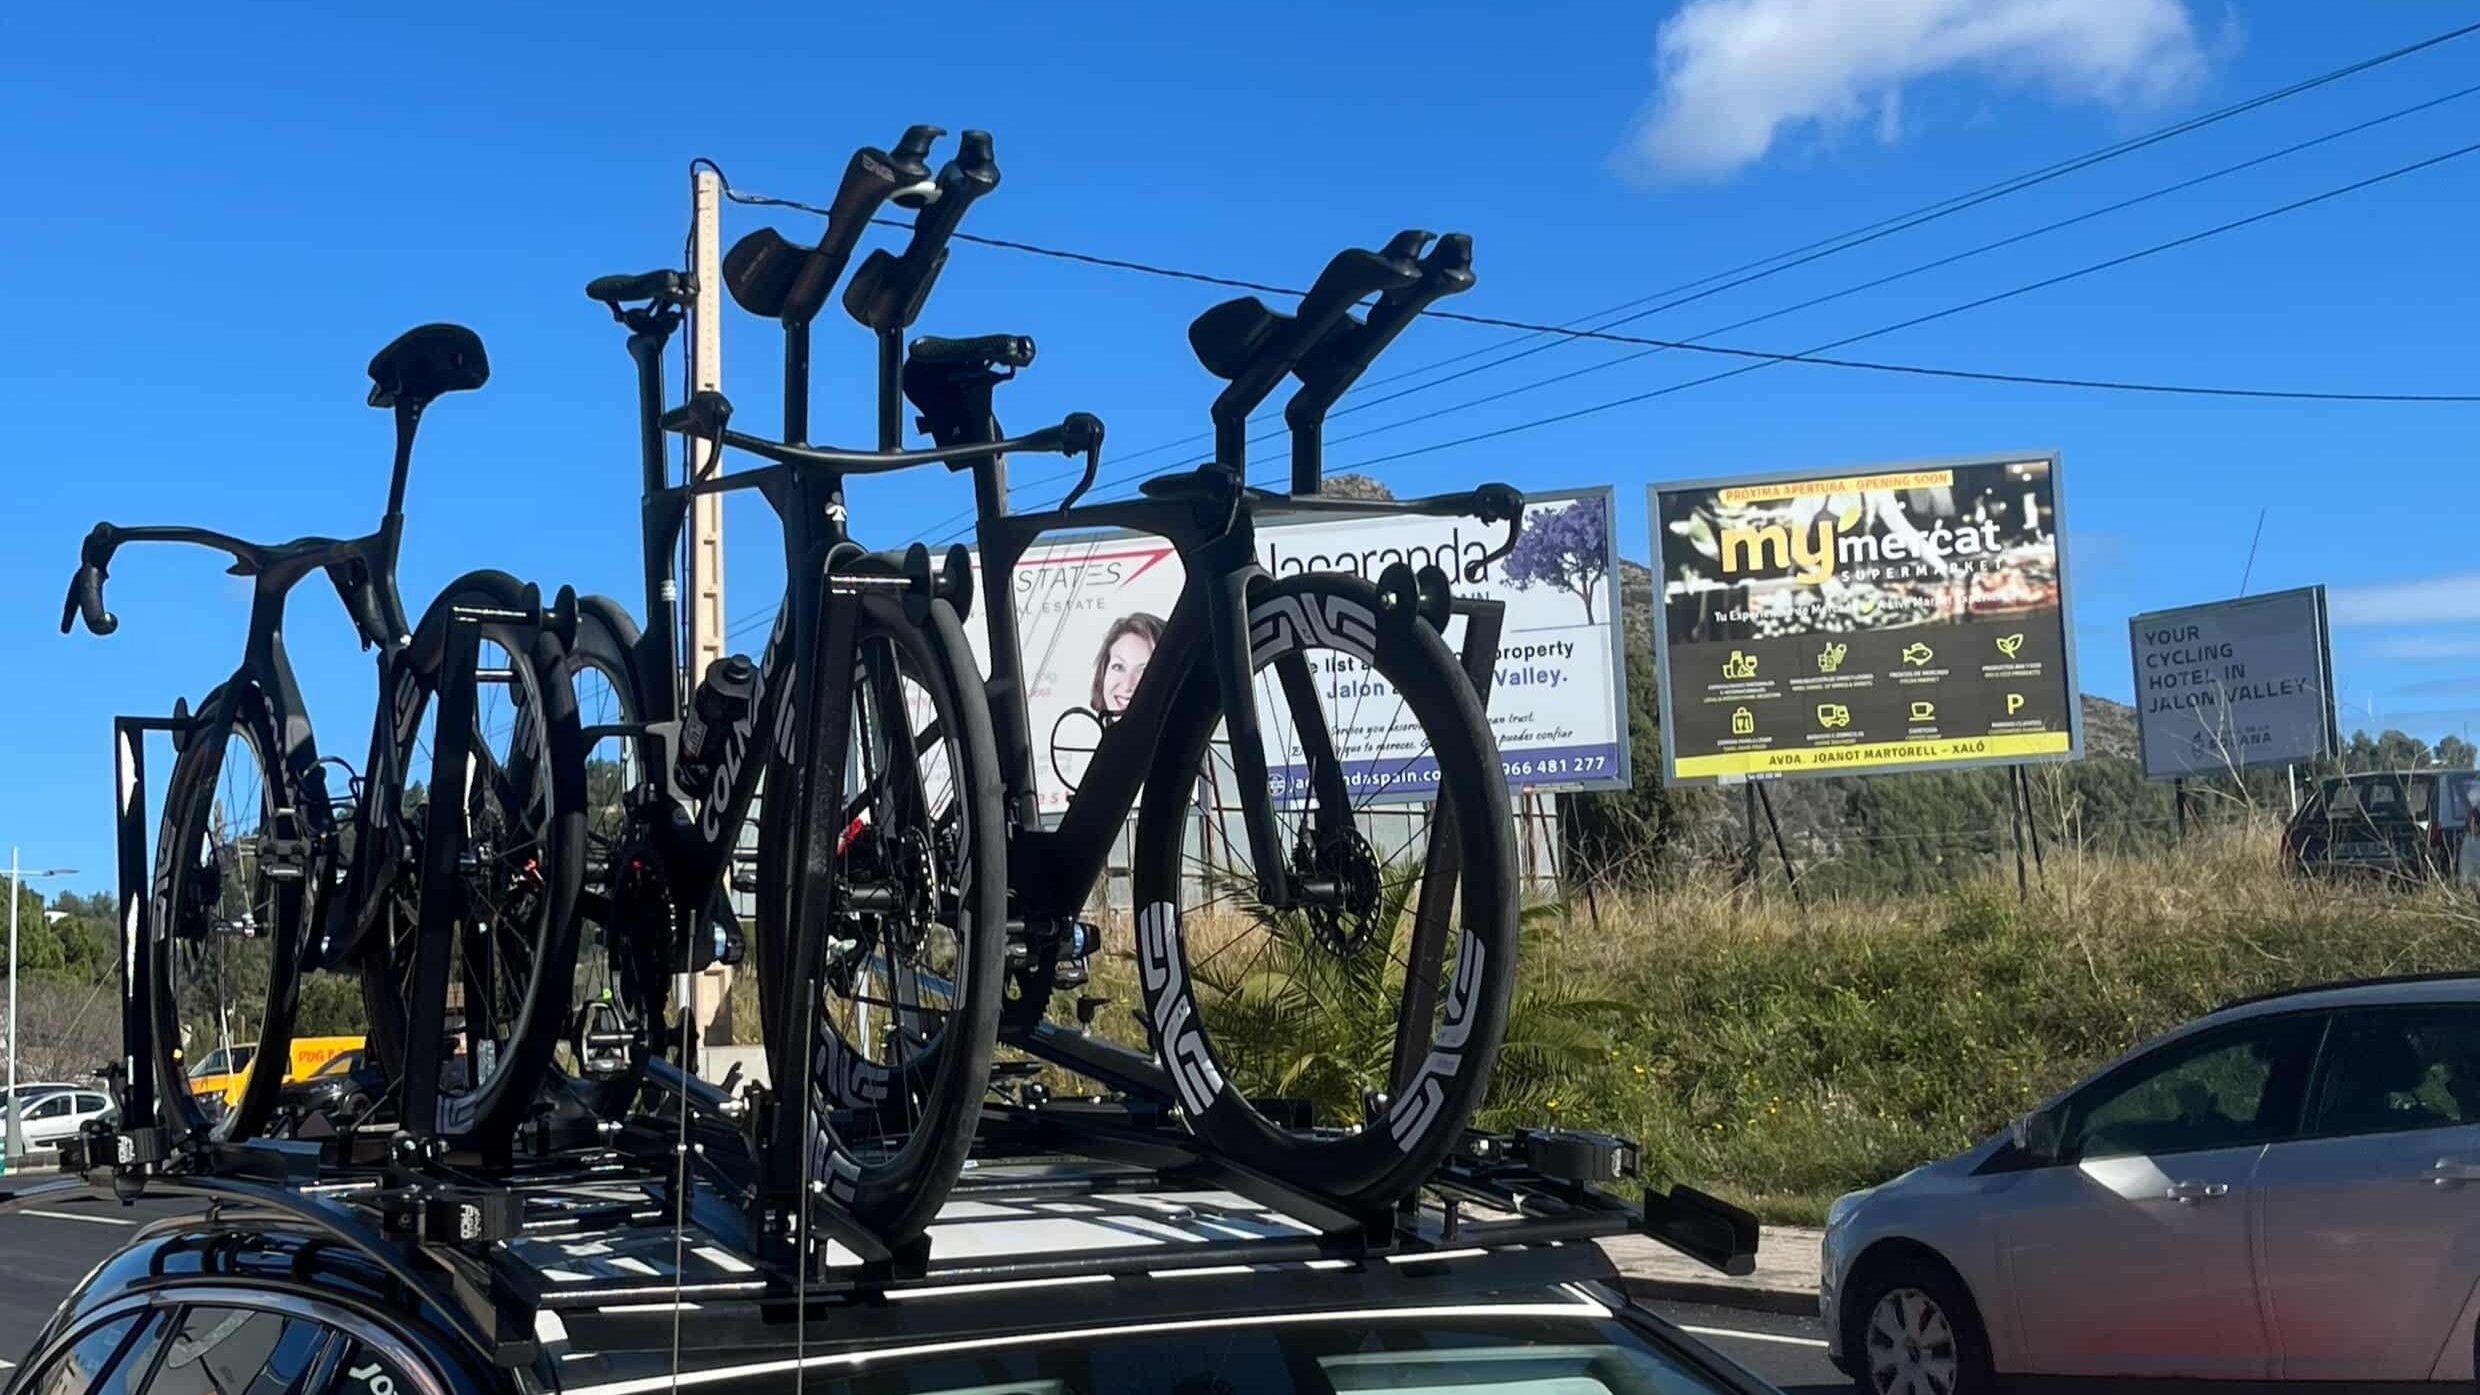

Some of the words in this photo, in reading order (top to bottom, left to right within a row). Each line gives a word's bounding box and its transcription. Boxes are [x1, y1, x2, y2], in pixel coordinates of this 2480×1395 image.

[1856, 475, 1911, 491] OPENING
[1914, 473, 1948, 485] SOON
[1720, 520, 1835, 585] my
[1015, 561, 1122, 593] STATES
[1041, 597, 1105, 614] ESTATE
[2145, 625, 2200, 646] YOUR
[2146, 643, 2233, 668] CYCLING
[1327, 680, 1385, 699] Jalon
[1494, 667, 1568, 688] Valley.
[2150, 668, 2216, 690] HOTEL
[2225, 663, 2246, 681] IN
[2007, 693, 2025, 716] P
[2149, 691, 2215, 713] JALON
[2223, 676, 2308, 703] VALLEY
[1535, 726, 1574, 742] confiar
[1812, 750, 1860, 763] JOANOT
[1864, 744, 1937, 760] MARTORELL
[1952, 741, 1985, 754] XALÓ
[1503, 762, 1533, 776] 966
[1537, 759, 1567, 773] 481
[1574, 756, 1606, 772] 277
[348, 1362, 400, 1395] JO
